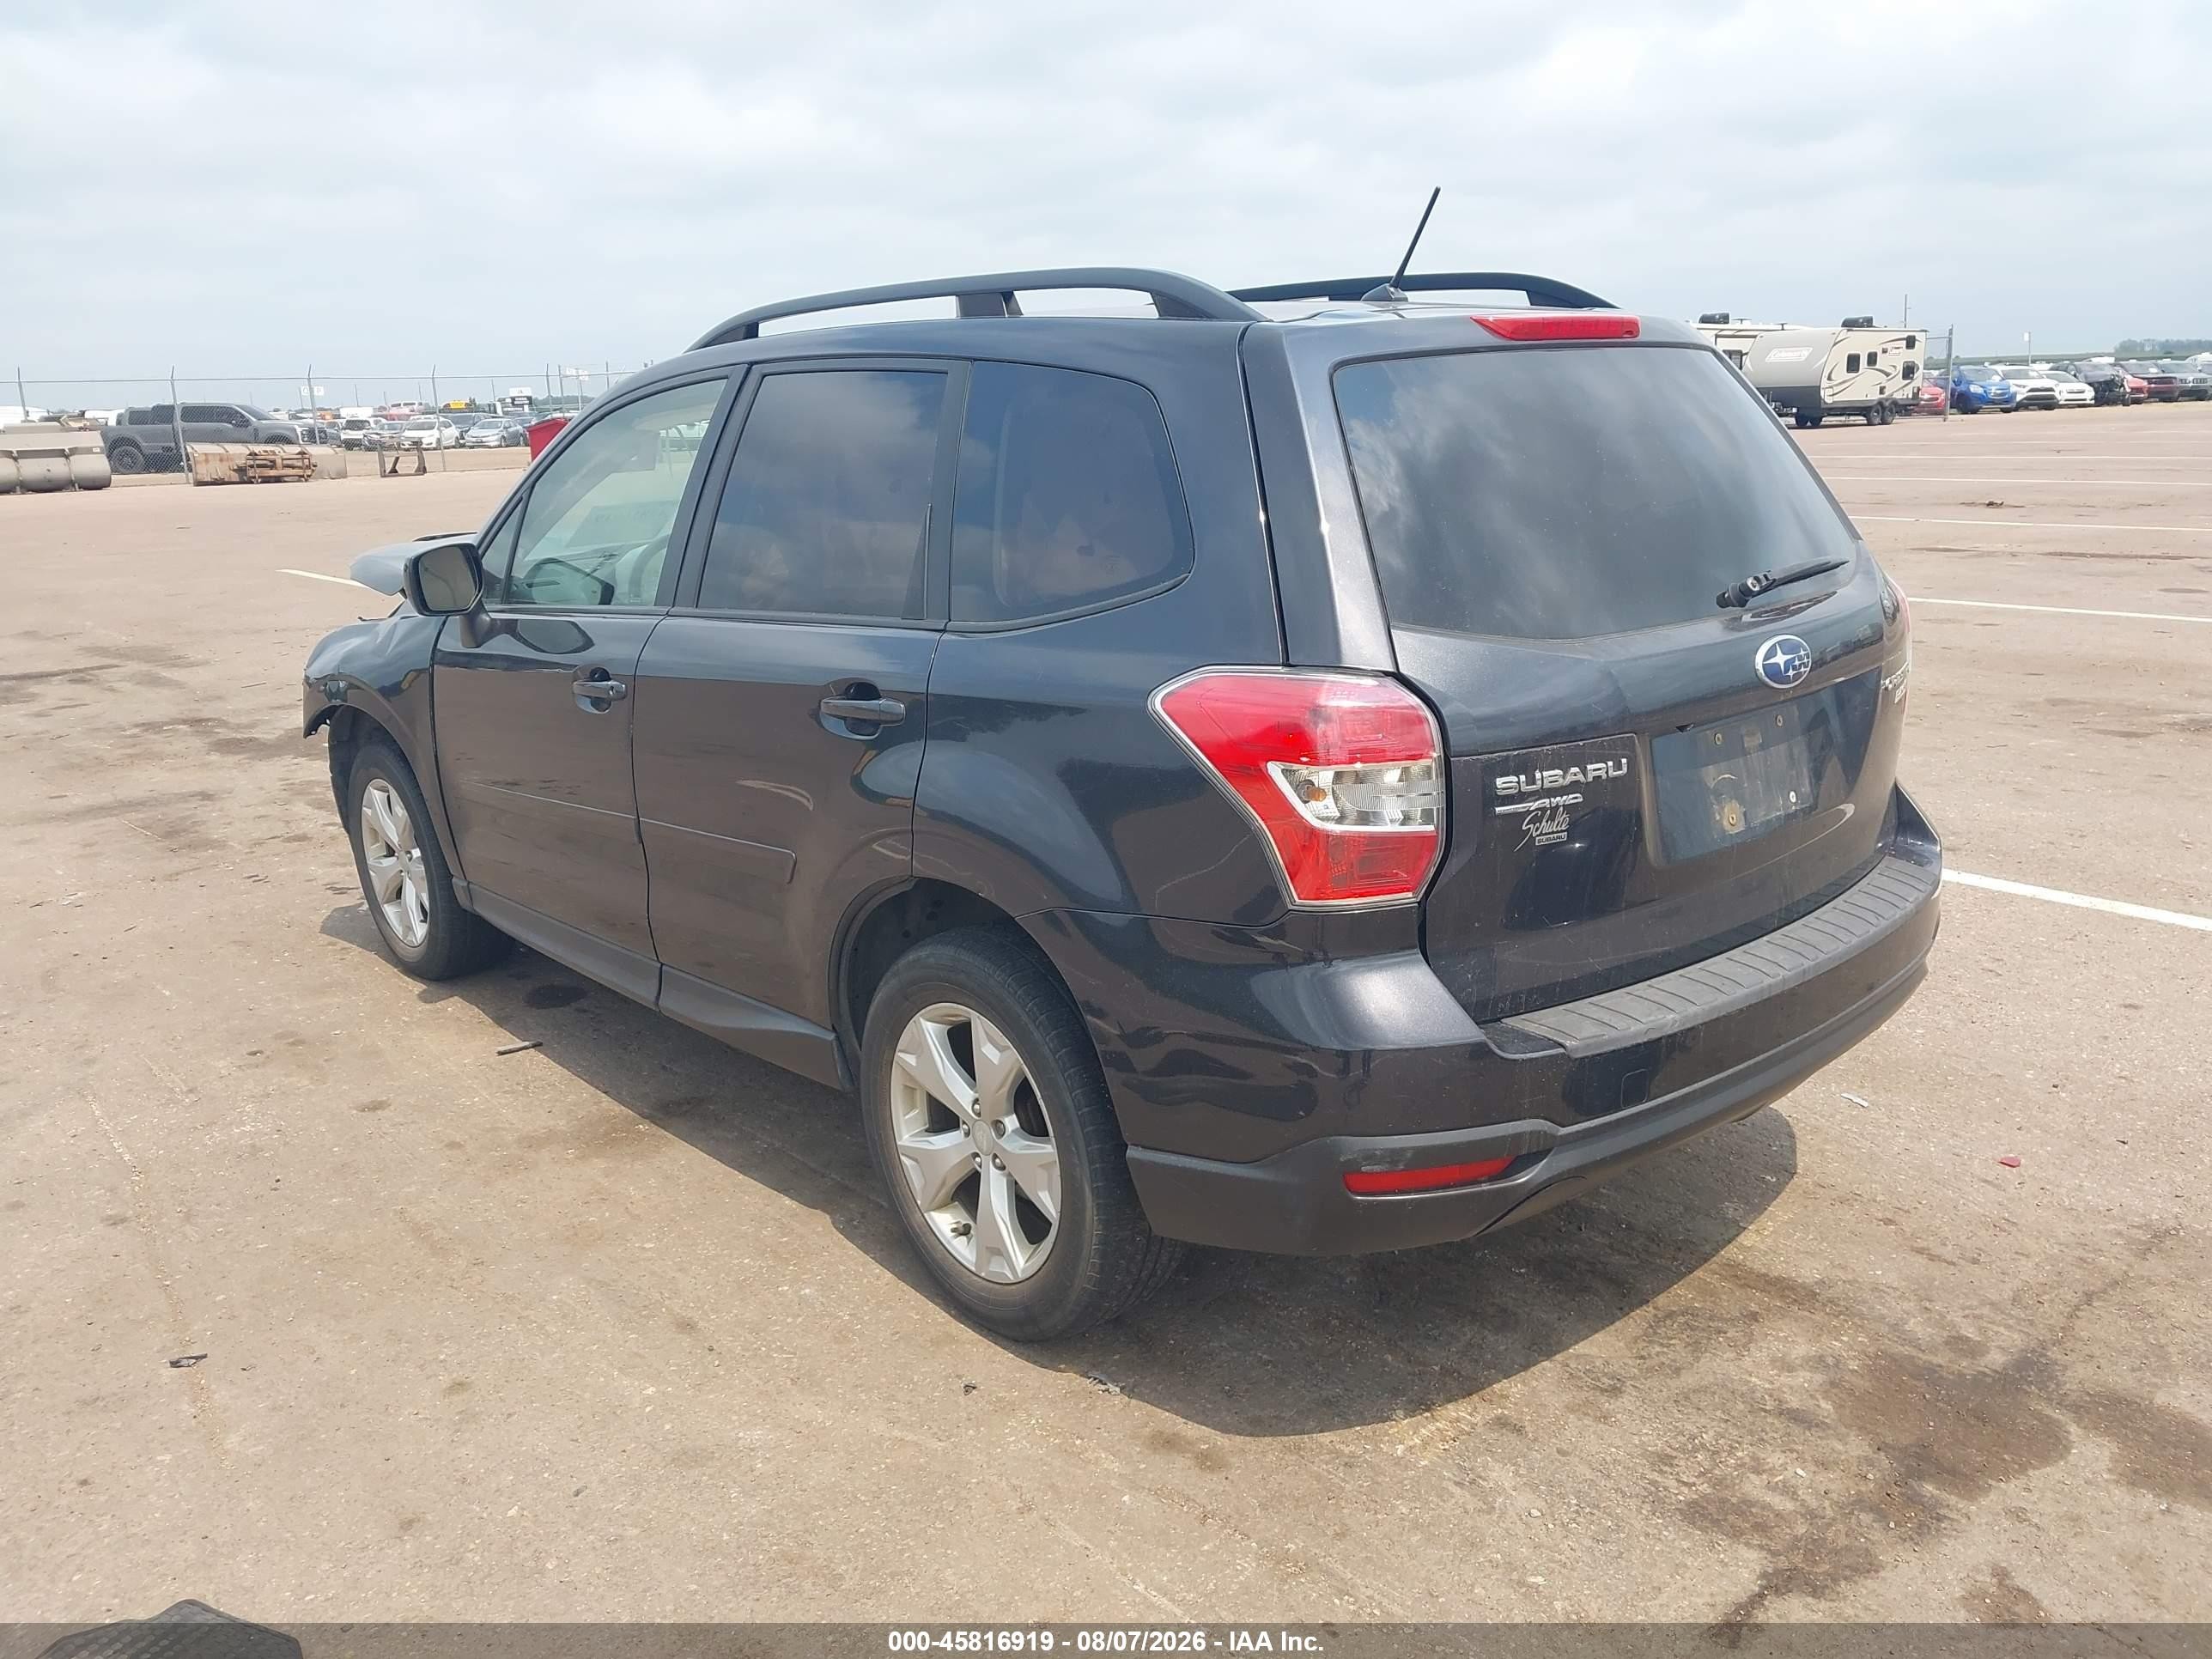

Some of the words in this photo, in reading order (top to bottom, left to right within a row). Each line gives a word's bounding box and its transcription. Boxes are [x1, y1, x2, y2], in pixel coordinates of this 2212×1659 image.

[1496, 757, 1627, 796] SUBARU
[1528, 793, 1583, 811] AWD
[1514, 806, 1571, 852] Schulte
[1536, 833, 1567, 845] SUBARU
